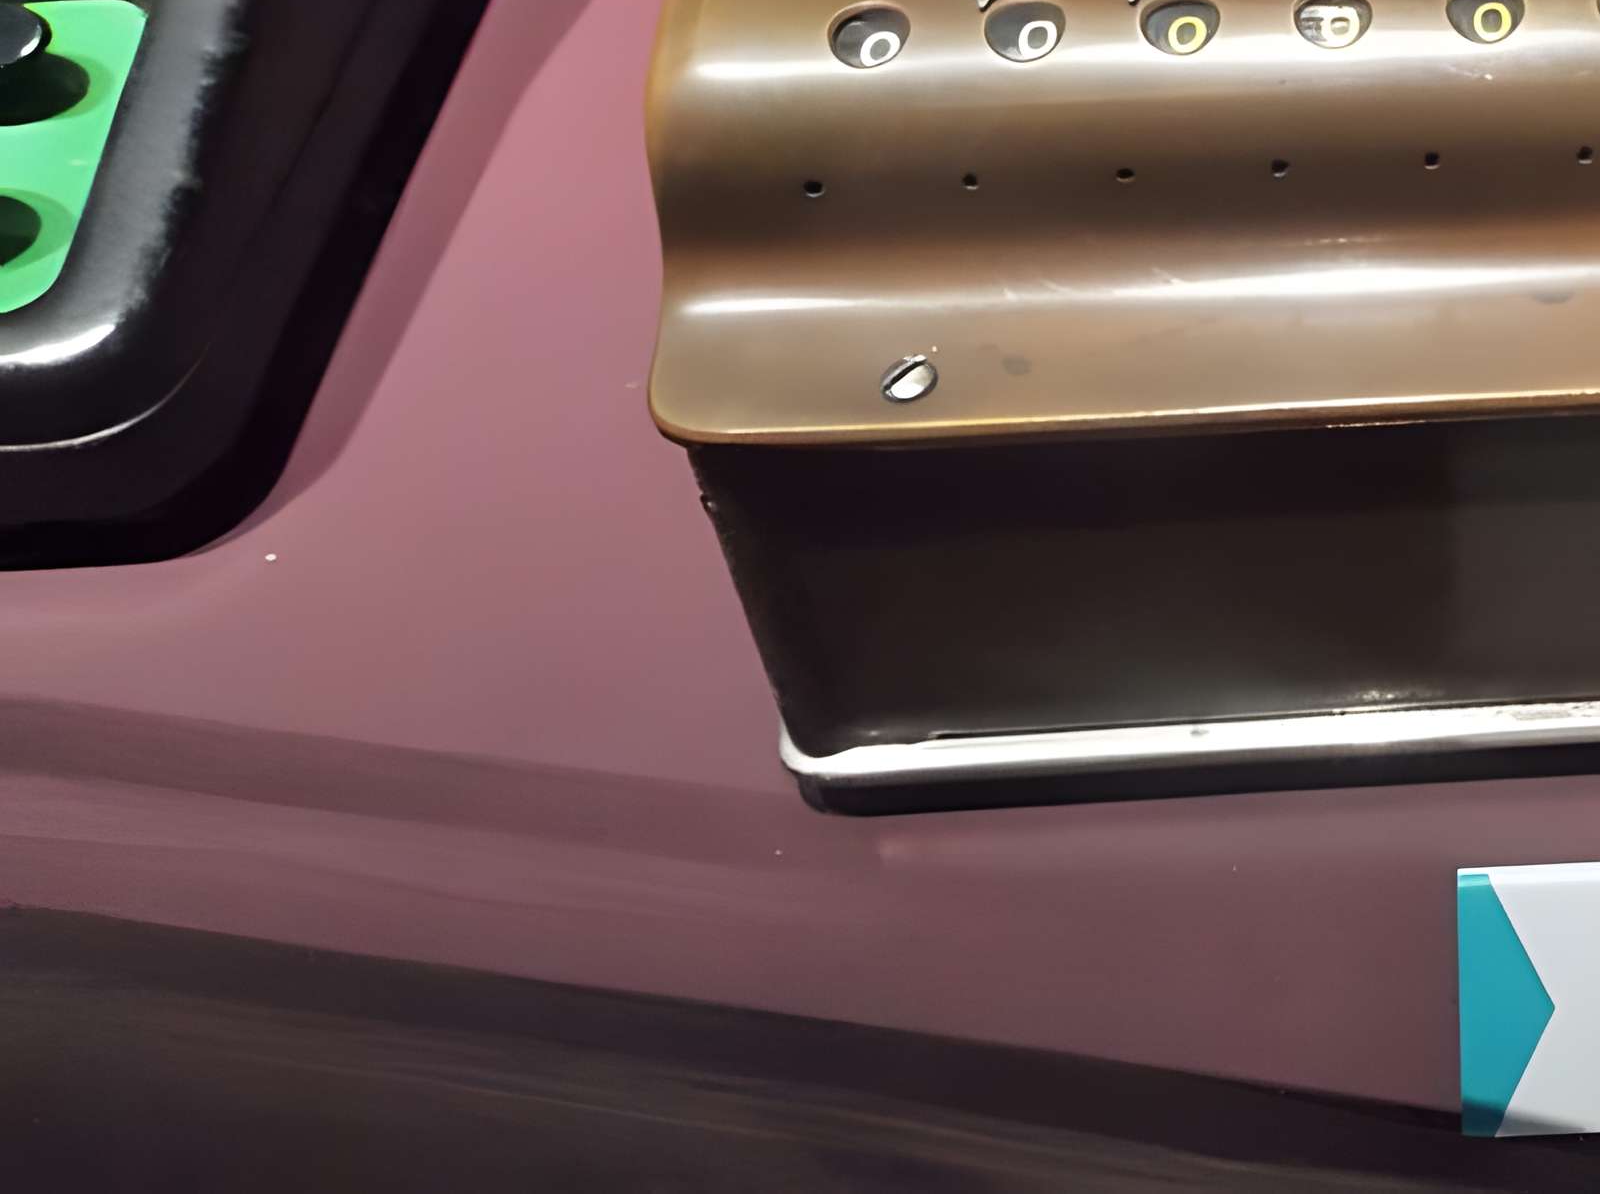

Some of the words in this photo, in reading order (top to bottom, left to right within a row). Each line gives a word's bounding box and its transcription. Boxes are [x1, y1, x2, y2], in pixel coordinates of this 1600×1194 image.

[860, 31, 901, 67] 0
[1018, 20, 1057, 59] 0
[1168, 16, 1206, 54] 0
[1473, 2, 1511, 41] 0
